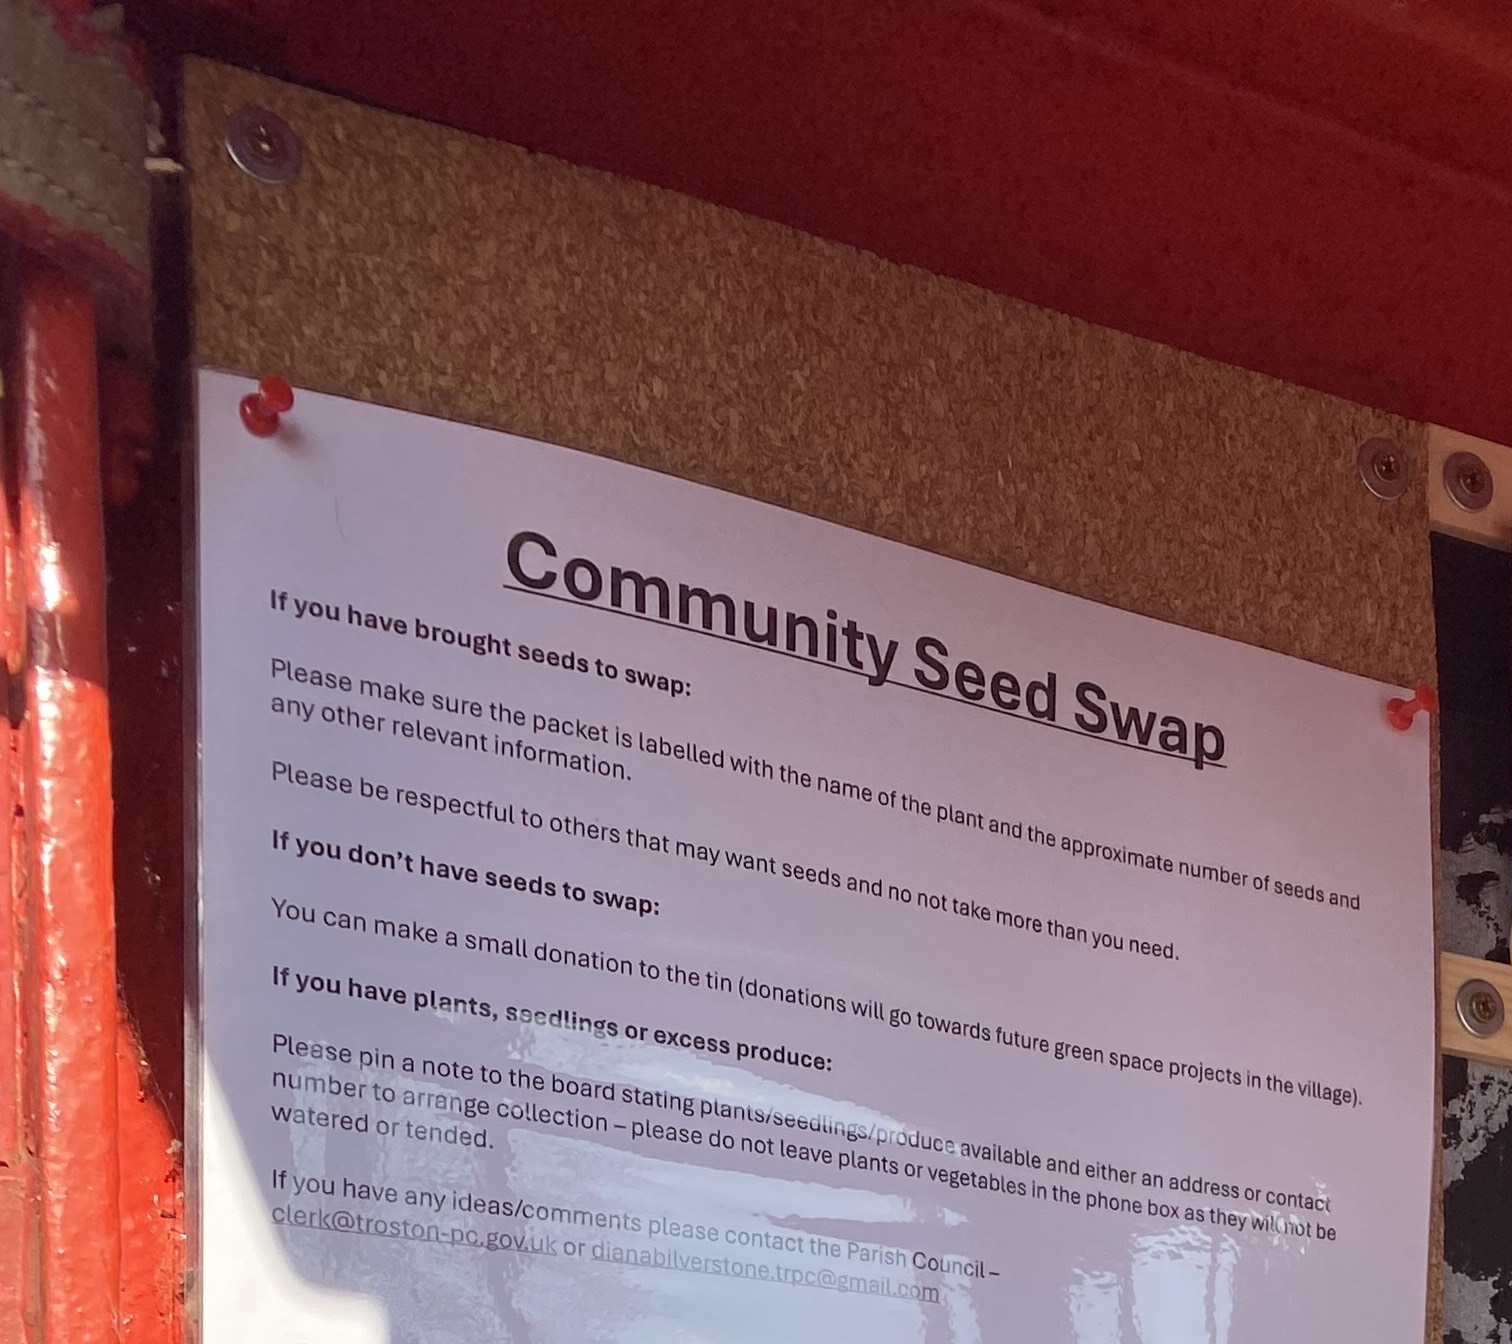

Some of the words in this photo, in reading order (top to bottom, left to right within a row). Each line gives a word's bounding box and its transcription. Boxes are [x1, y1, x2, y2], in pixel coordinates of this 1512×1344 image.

[270, 588, 288, 612] If
[293, 597, 340, 622] you
[347, 603, 408, 636] have
[414, 617, 512, 658] brought
[517, 644, 589, 674] seeds
[594, 658, 619, 680] to
[624, 668, 692, 698] swap:
[506, 531, 899, 687] Community
[914, 636, 1057, 723] Seed
[1074, 681, 1226, 769] Swap
[270, 696, 315, 723] any
[321, 705, 386, 733] other
[392, 719, 488, 753] relevant
[494, 733, 632, 782] information.
[271, 657, 353, 693] Please
[359, 679, 425, 707] make
[431, 693, 483, 718] sure
[489, 701, 526, 727] the
[532, 713, 609, 744] packet
[615, 725, 633, 749] is
[638, 731, 725, 769] labelled
[729, 754, 774, 781] with
[779, 764, 812, 789] the
[817, 776, 873, 803] name
[877, 790, 897, 809] of
[901, 793, 932, 817] the
[936, 803, 985, 831] plant
[988, 818, 1023, 840] and
[1027, 825, 1057, 848] the
[1060, 836, 1174, 874] approximate
[1178, 861, 1249, 887] number
[1252, 874, 1270, 892] of
[1273, 880, 1325, 903] seeds
[1328, 892, 1361, 911] and
[272, 760, 353, 795] Please
[359, 776, 389, 801] be
[396, 787, 516, 825] respectful
[520, 807, 543, 830] to
[549, 815, 621, 844] others
[626, 828, 670, 854] that
[675, 840, 721, 867] may
[724, 850, 777, 876] want
[781, 862, 842, 889] seeds
[846, 876, 883, 898] and
[888, 885, 912, 904] no
[917, 892, 948, 912] not
[952, 897, 991, 922] take
[995, 909, 1043, 934] more
[1046, 918, 1088, 944] than
[1091, 930, 1124, 951] you
[1128, 938, 1180, 962] need.
[272, 828, 290, 851] If
[295, 837, 342, 861] you
[348, 843, 414, 874] don't
[420, 854, 479, 884] have
[485, 870, 557, 897] seeds
[562, 881, 586, 902] to
[592, 889, 660, 918] swap:
[270, 896, 316, 924] You
[322, 910, 367, 933] can
[374, 918, 438, 944] make
[444, 930, 458, 948] a
[464, 933, 529, 959] small
[533, 941, 633, 977] donation
[638, 959, 661, 980] to
[665, 964, 701, 987] the
[705, 970, 733, 993] tin
[738, 975, 847, 1014] (donations
[850, 999, 885, 1022] will
[888, 1008, 912, 1028] go
[916, 1011, 991, 1042] towards
[995, 1025, 1050, 1054] future
[1053, 1041, 1104, 1064] green
[1108, 1051, 1164, 1074] space
[1168, 1061, 1242, 1086] projects
[1246, 1069, 1262, 1090] in
[1265, 1074, 1294, 1095] the
[1297, 1079, 1363, 1109] village).
[270, 1168, 288, 1191] If
[292, 1174, 336, 1197] you
[342, 1176, 398, 1204] have
[404, 1189, 447, 1214] any
[452, 1189, 642, 1233] ideas/comments
[648, 1216, 719, 1243] please
[724, 1229, 805, 1254] contact
[809, 1237, 841, 1258] the
[847, 1237, 907, 1268] Parish
[911, 1250, 986, 1280] Council
[563, 1240, 587, 1257] or
